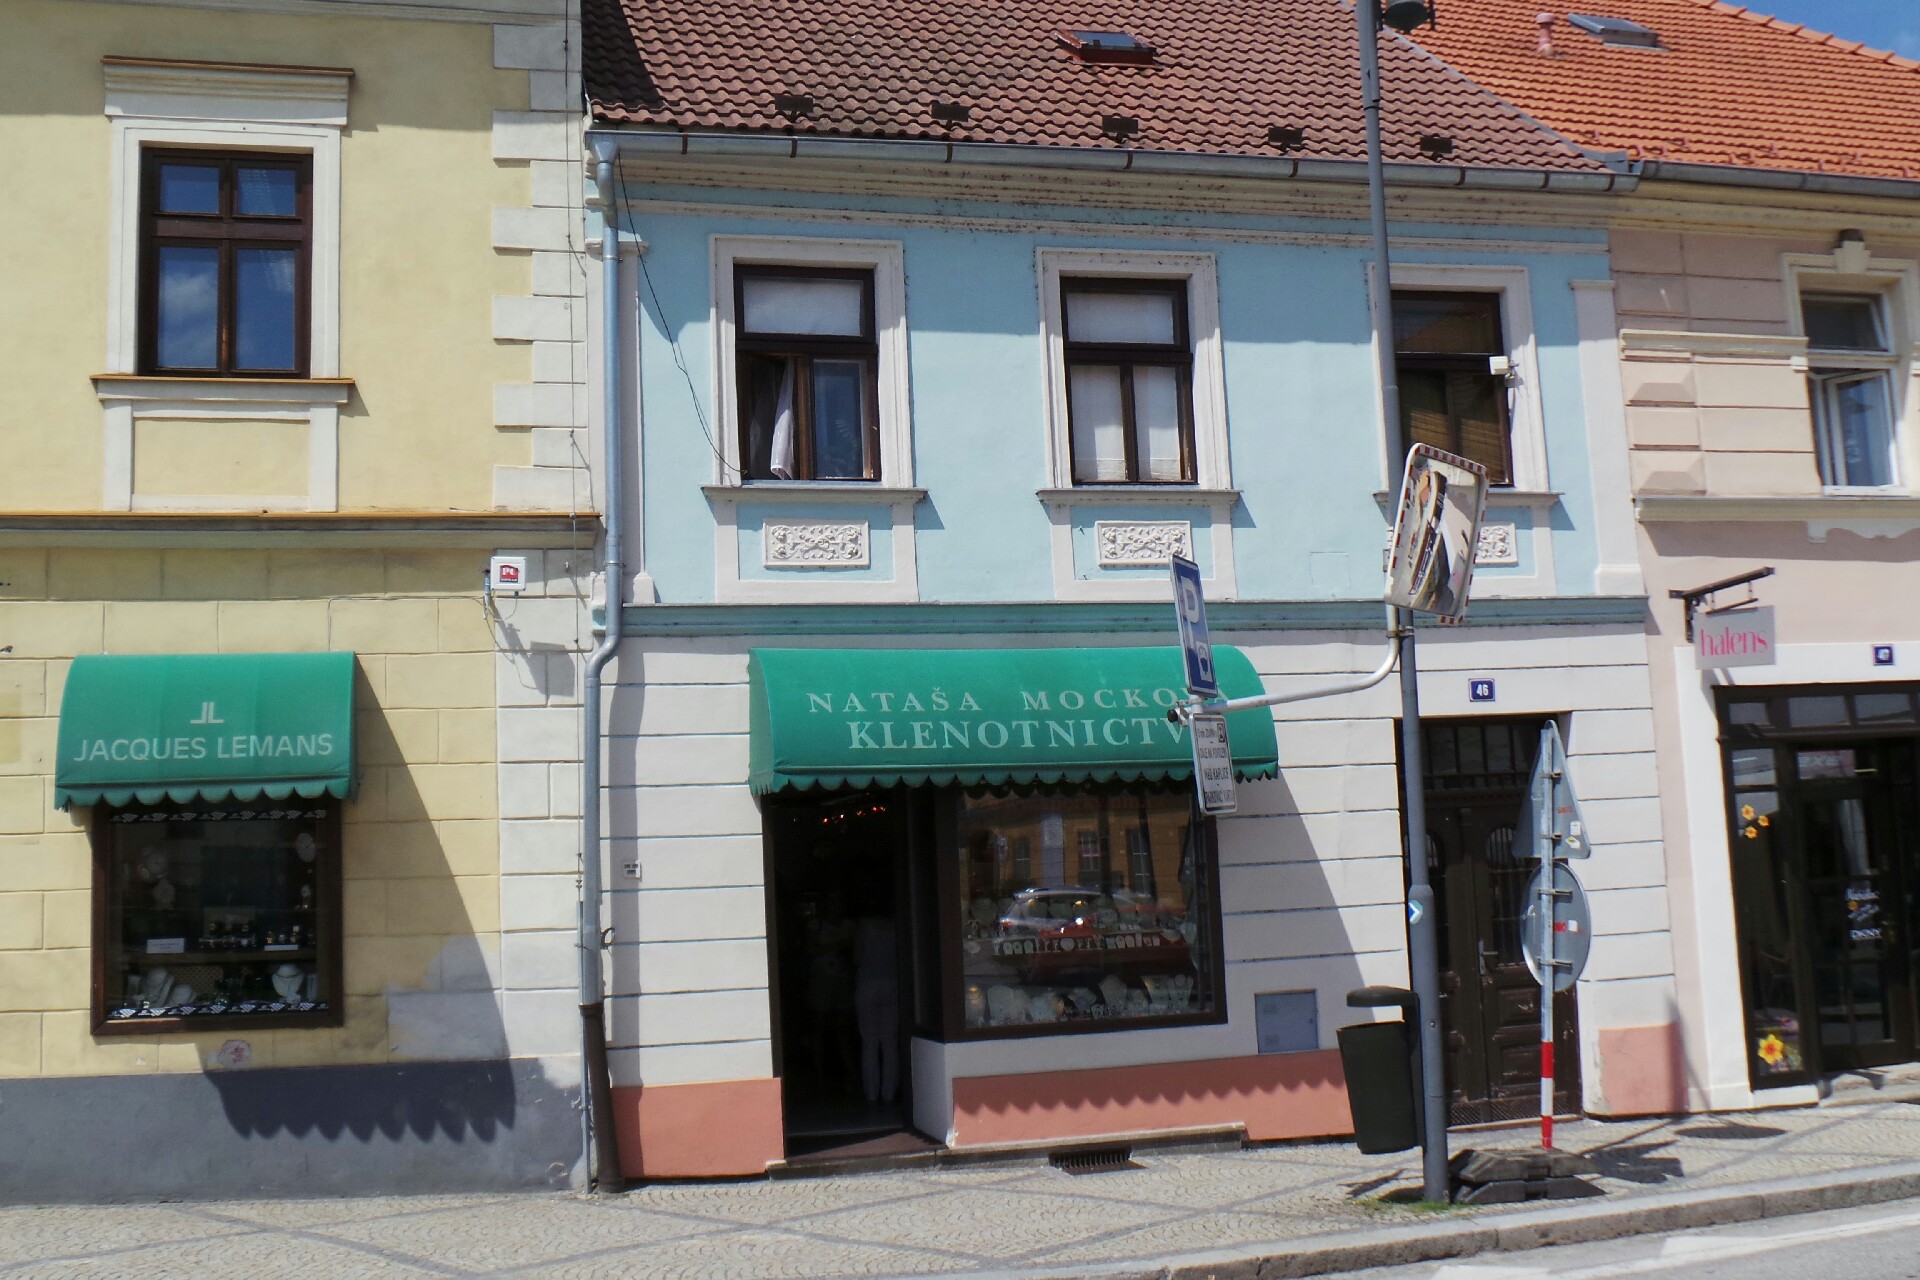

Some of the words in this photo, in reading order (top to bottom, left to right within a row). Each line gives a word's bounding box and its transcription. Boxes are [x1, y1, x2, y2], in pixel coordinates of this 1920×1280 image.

[1181, 575, 1200, 648] P
[1700, 626, 1769, 656] halens
[806, 687, 981, 713] NATAŠA
[1020, 683, 1229, 711] MOCKO
[1476, 684, 1489, 697] 46
[73, 737, 206, 762] JACQUES
[217, 733, 333, 759] LEMANS
